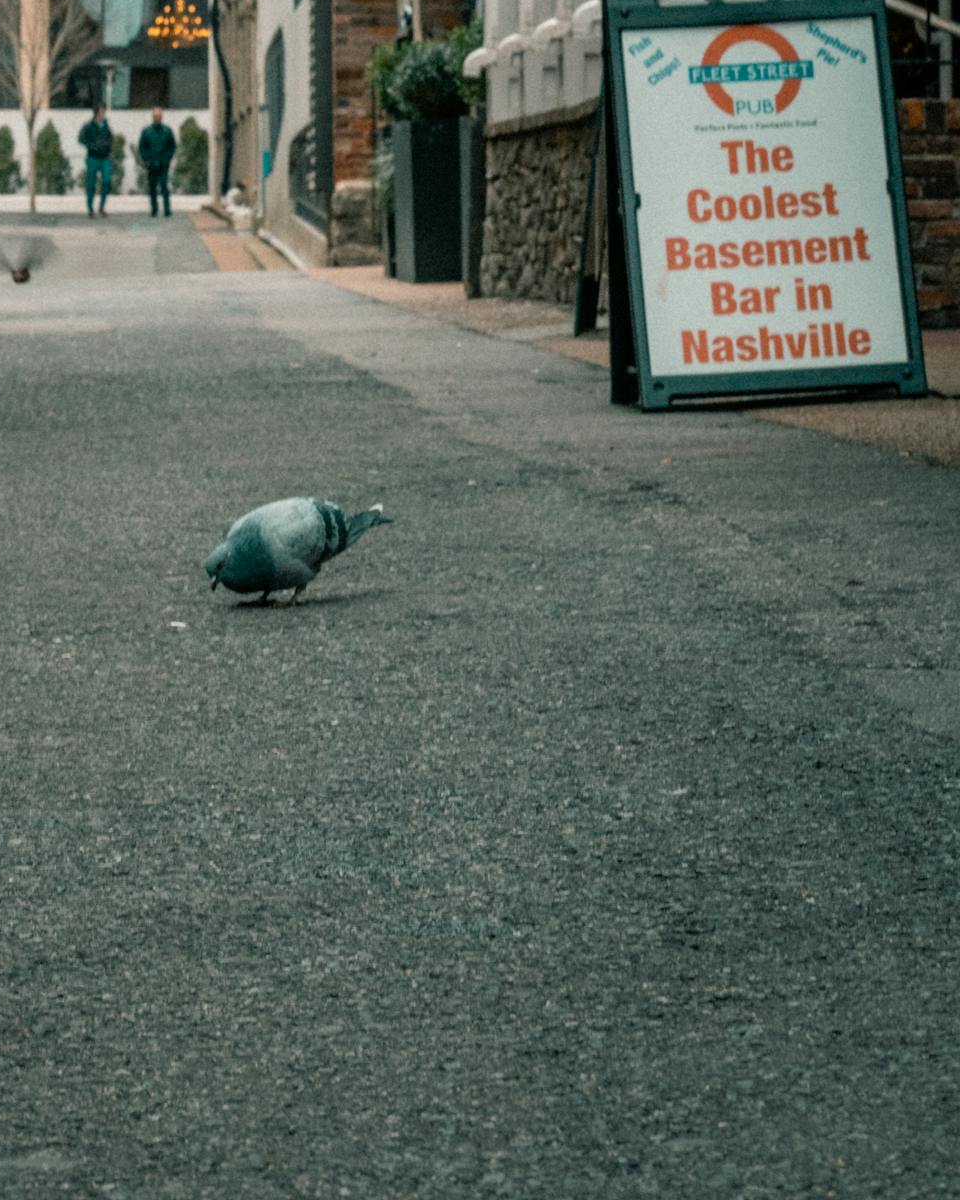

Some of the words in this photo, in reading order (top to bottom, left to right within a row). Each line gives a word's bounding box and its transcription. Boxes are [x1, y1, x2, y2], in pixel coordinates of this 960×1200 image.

[691, 64, 741, 84] FLEET
[747, 61, 810, 81] STREET
[736, 99, 775, 115] PUB
[720, 140, 795, 175] The
[686, 182, 839, 224] Coolest
[665, 227, 871, 271] Basement
[710, 281, 780, 317] Bar
[795, 277, 833, 311] in
[681, 321, 872, 364] Nashville
